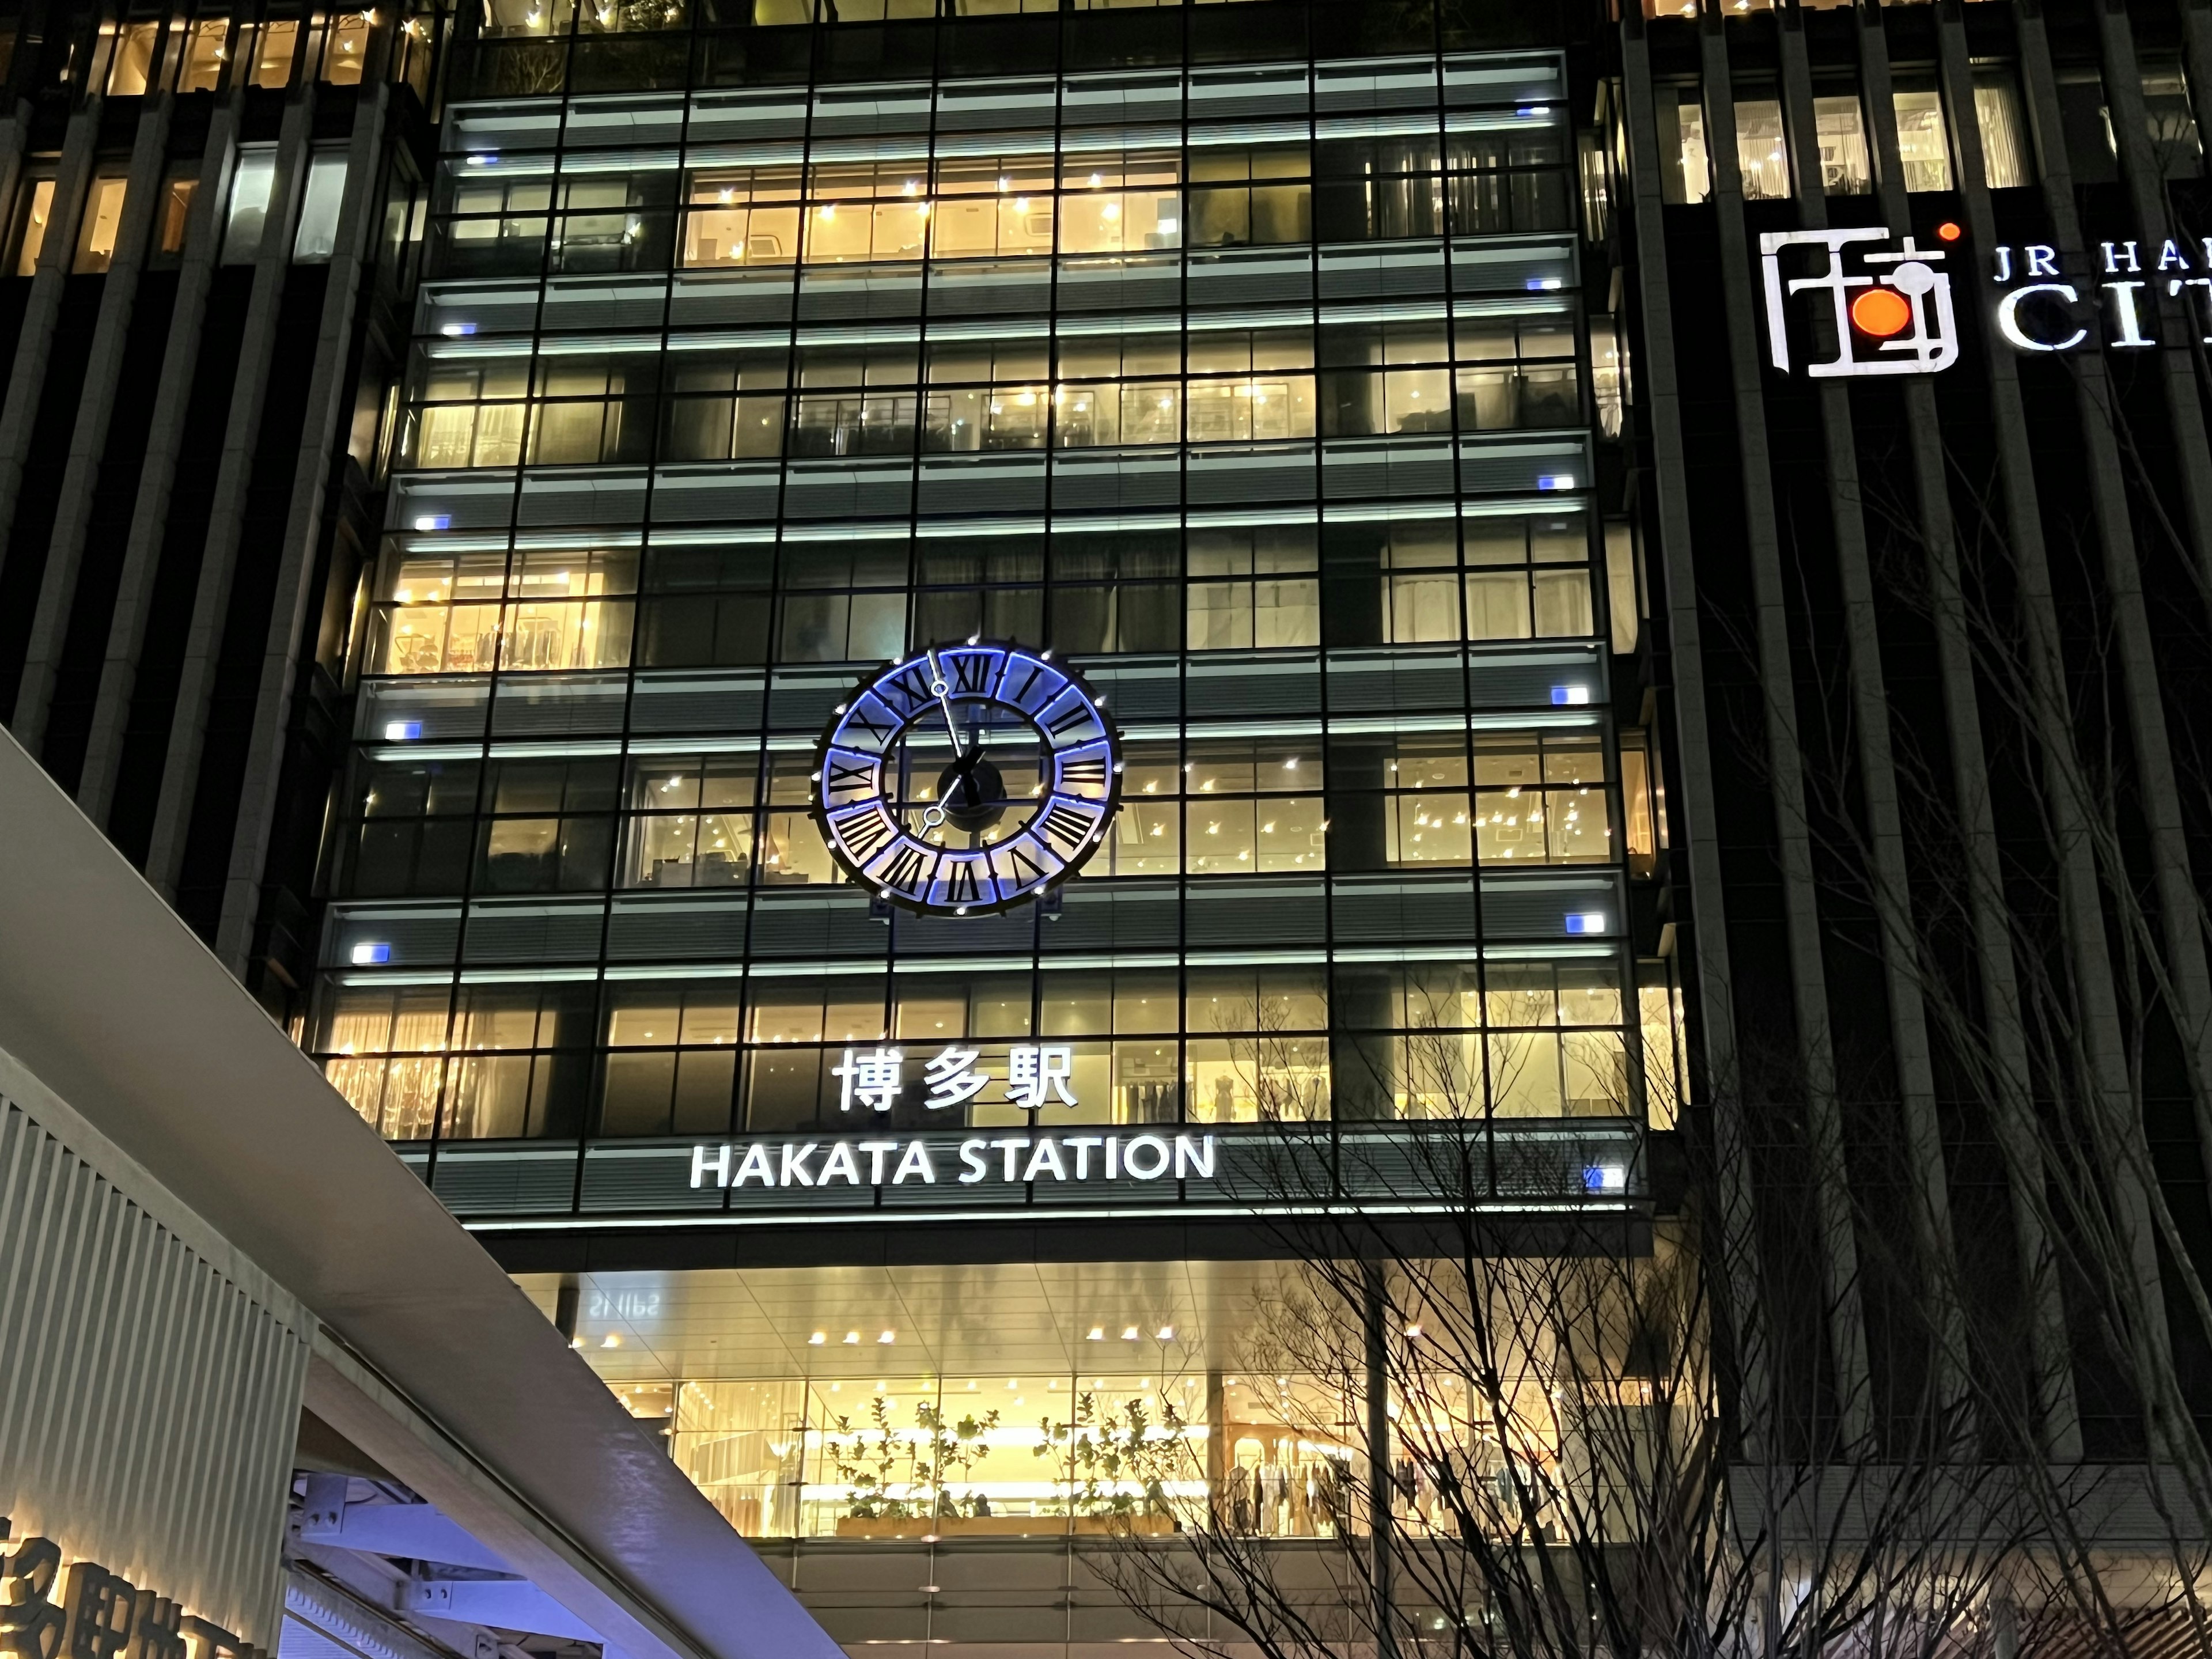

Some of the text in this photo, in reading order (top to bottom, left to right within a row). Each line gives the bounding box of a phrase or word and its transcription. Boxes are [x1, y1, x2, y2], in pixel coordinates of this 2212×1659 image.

[1993, 237, 2212, 282] JR HA
[950, 654, 994, 692] XII
[1014, 666, 1043, 703] I
[846, 709, 895, 745] X
[1047, 702, 1093, 738] II
[829, 760, 874, 794] IX
[1060, 757, 1106, 786] III
[945, 860, 980, 902] VI
[1008, 847, 1048, 890] V
[832, 1046, 1078, 1112] 博多駅
[688, 1135, 1215, 1188] HAKATA STATION
